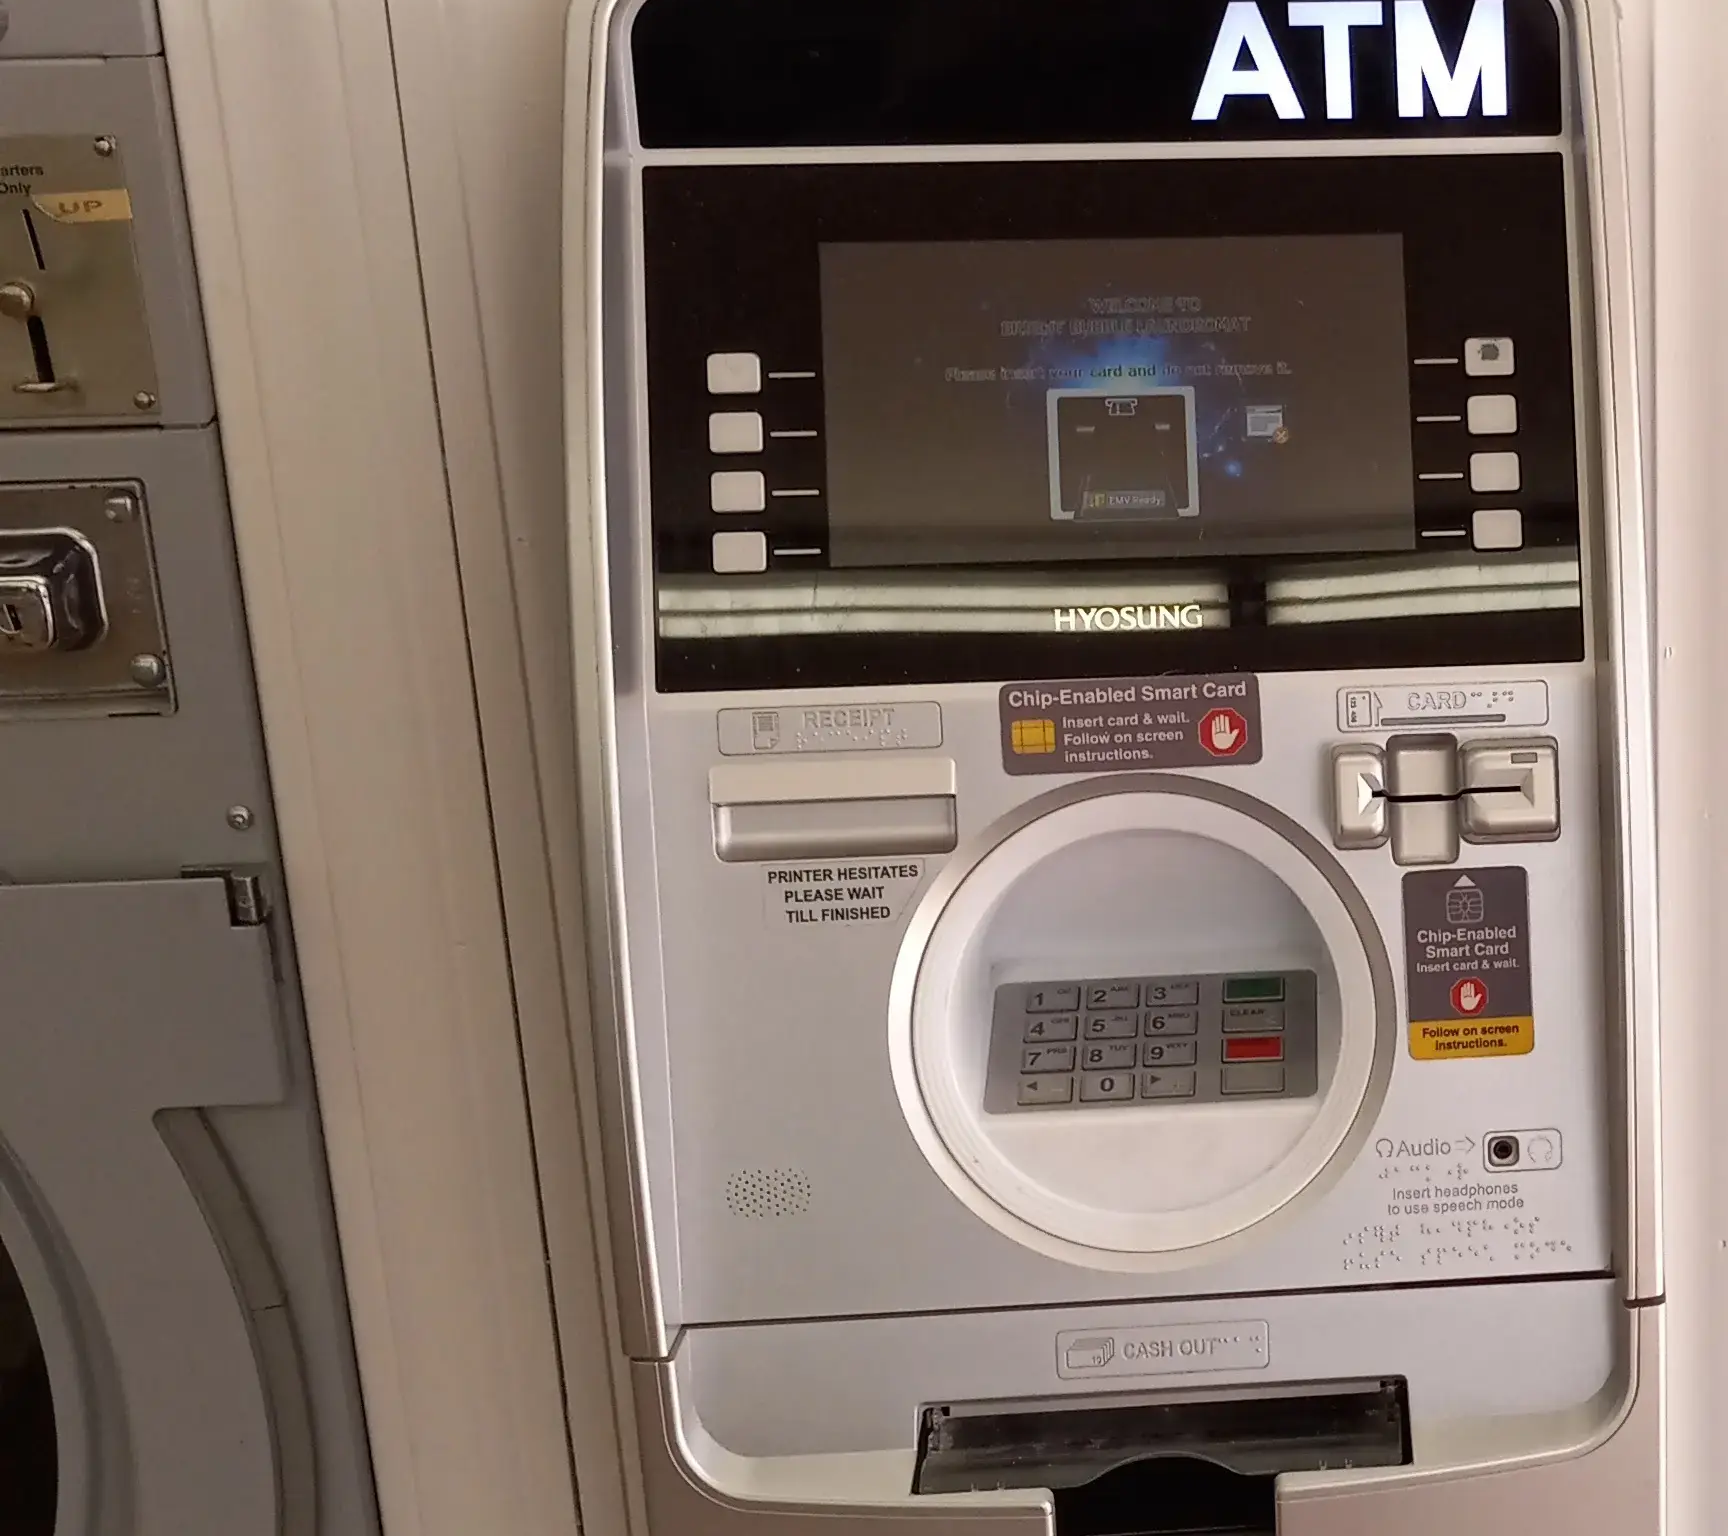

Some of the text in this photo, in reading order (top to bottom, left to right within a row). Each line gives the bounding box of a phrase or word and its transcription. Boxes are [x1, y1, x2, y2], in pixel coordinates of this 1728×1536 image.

[0, 183, 32, 197] Only
[58, 200, 102, 217] UP
[1054, 605, 1203, 632] HYOSUNG
[1009, 681, 1247, 709] Chip-Enabled Smart Card
[1408, 691, 1467, 710] CARD
[802, 708, 895, 729] RECEIPT
[1062, 711, 1190, 729] Insert card & wait.
[1064, 730, 1184, 746] Follow on screen
[1064, 749, 1154, 763] instructions.
[768, 864, 919, 884] PRINTER HESITATES
[784, 886, 885, 903] PLEASE WAIT
[786, 907, 891, 923] TILL FINISHED
[1417, 925, 1517, 944] Chip-Enabled
[1426, 941, 1509, 959] Smart Card
[1417, 961, 1451, 973] Insert
[1453, 960, 1479, 971] card
[1481, 960, 1490, 970] &
[1034, 993, 1044, 1006] 1
[1094, 990, 1106, 1003] 2
[1153, 987, 1167, 1000] 3
[1030, 1022, 1045, 1036] 4
[1092, 1019, 1106, 1032] 5
[1152, 1016, 1166, 1030] 6
[1422, 1024, 1519, 1038] Follow on screen
[1028, 1052, 1042, 1066] 7
[1089, 1049, 1103, 1063] 8
[1151, 1046, 1164, 1060] 9
[1101, 1078, 1115, 1092] 0
[1396, 1139, 1452, 1158] Audio
[1393, 1183, 1519, 1201] Insert headphones
[1388, 1197, 1525, 1216] to use speech mode
[1123, 1339, 1217, 1360] CASH OUT
